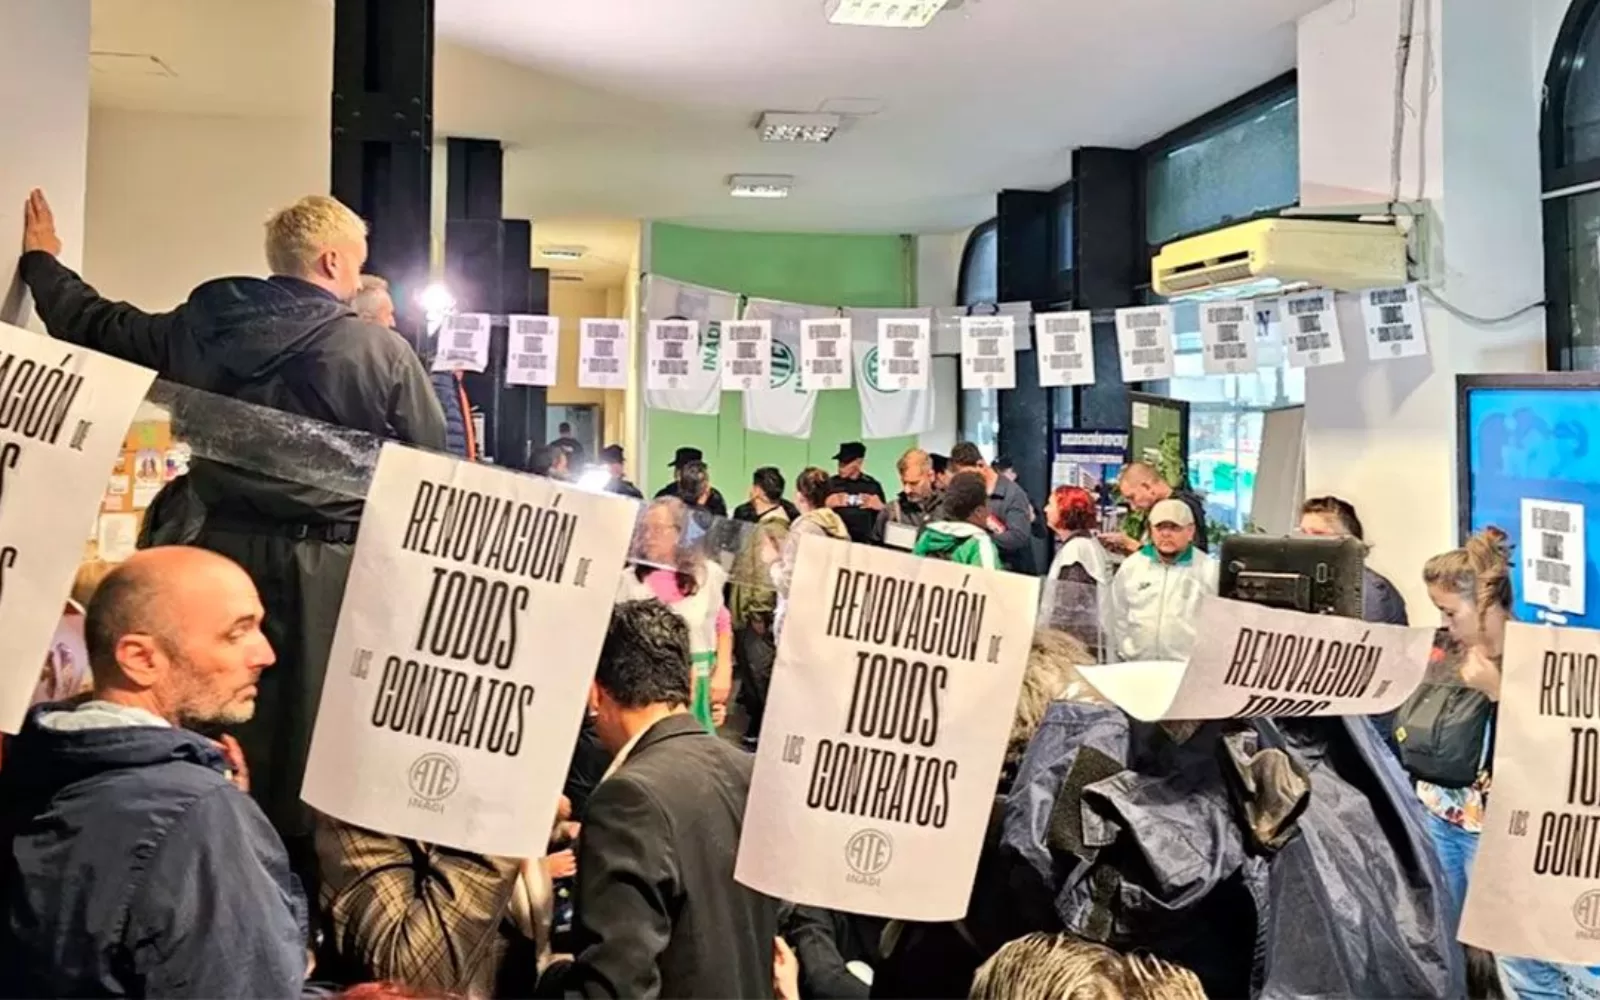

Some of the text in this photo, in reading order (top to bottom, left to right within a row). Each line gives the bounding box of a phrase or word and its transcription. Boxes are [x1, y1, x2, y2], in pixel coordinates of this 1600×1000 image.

[402, 480, 577, 584] RENOVACIÓN
[415, 567, 529, 670] TODOS
[826, 567, 987, 662] RENOVACIÓN
[371, 655, 535, 757] CONTRATOS
[845, 651, 948, 748] TODOS
[1224, 627, 1383, 698] RENOVACIÓN
[1540, 649, 1600, 719] RENO
[413, 757, 455, 797] ATE
[806, 739, 958, 829] CONTRATOS
[1567, 726, 1600, 806] TO
[849, 832, 889, 870] ATE
